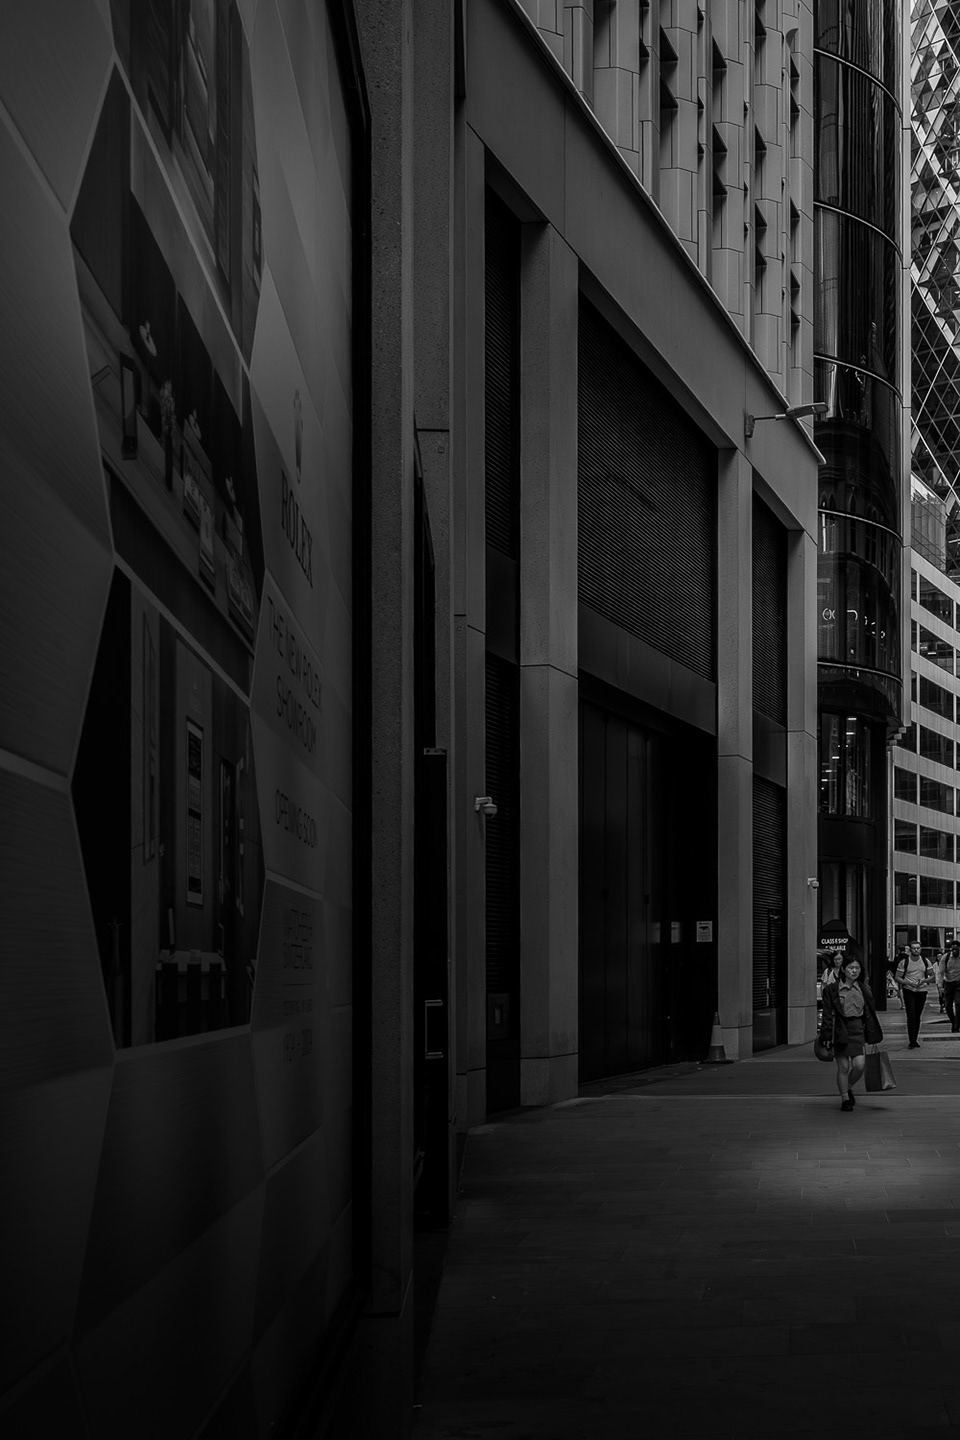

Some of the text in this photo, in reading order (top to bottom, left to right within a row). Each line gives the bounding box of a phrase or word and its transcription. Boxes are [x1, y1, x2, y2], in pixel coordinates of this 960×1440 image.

[281, 468, 314, 590] ROLEX
[267, 595, 323, 714] THE NEW ROLEX
[276, 675, 317, 758] SHOWROOM
[275, 788, 317, 849] OPENING SOON
